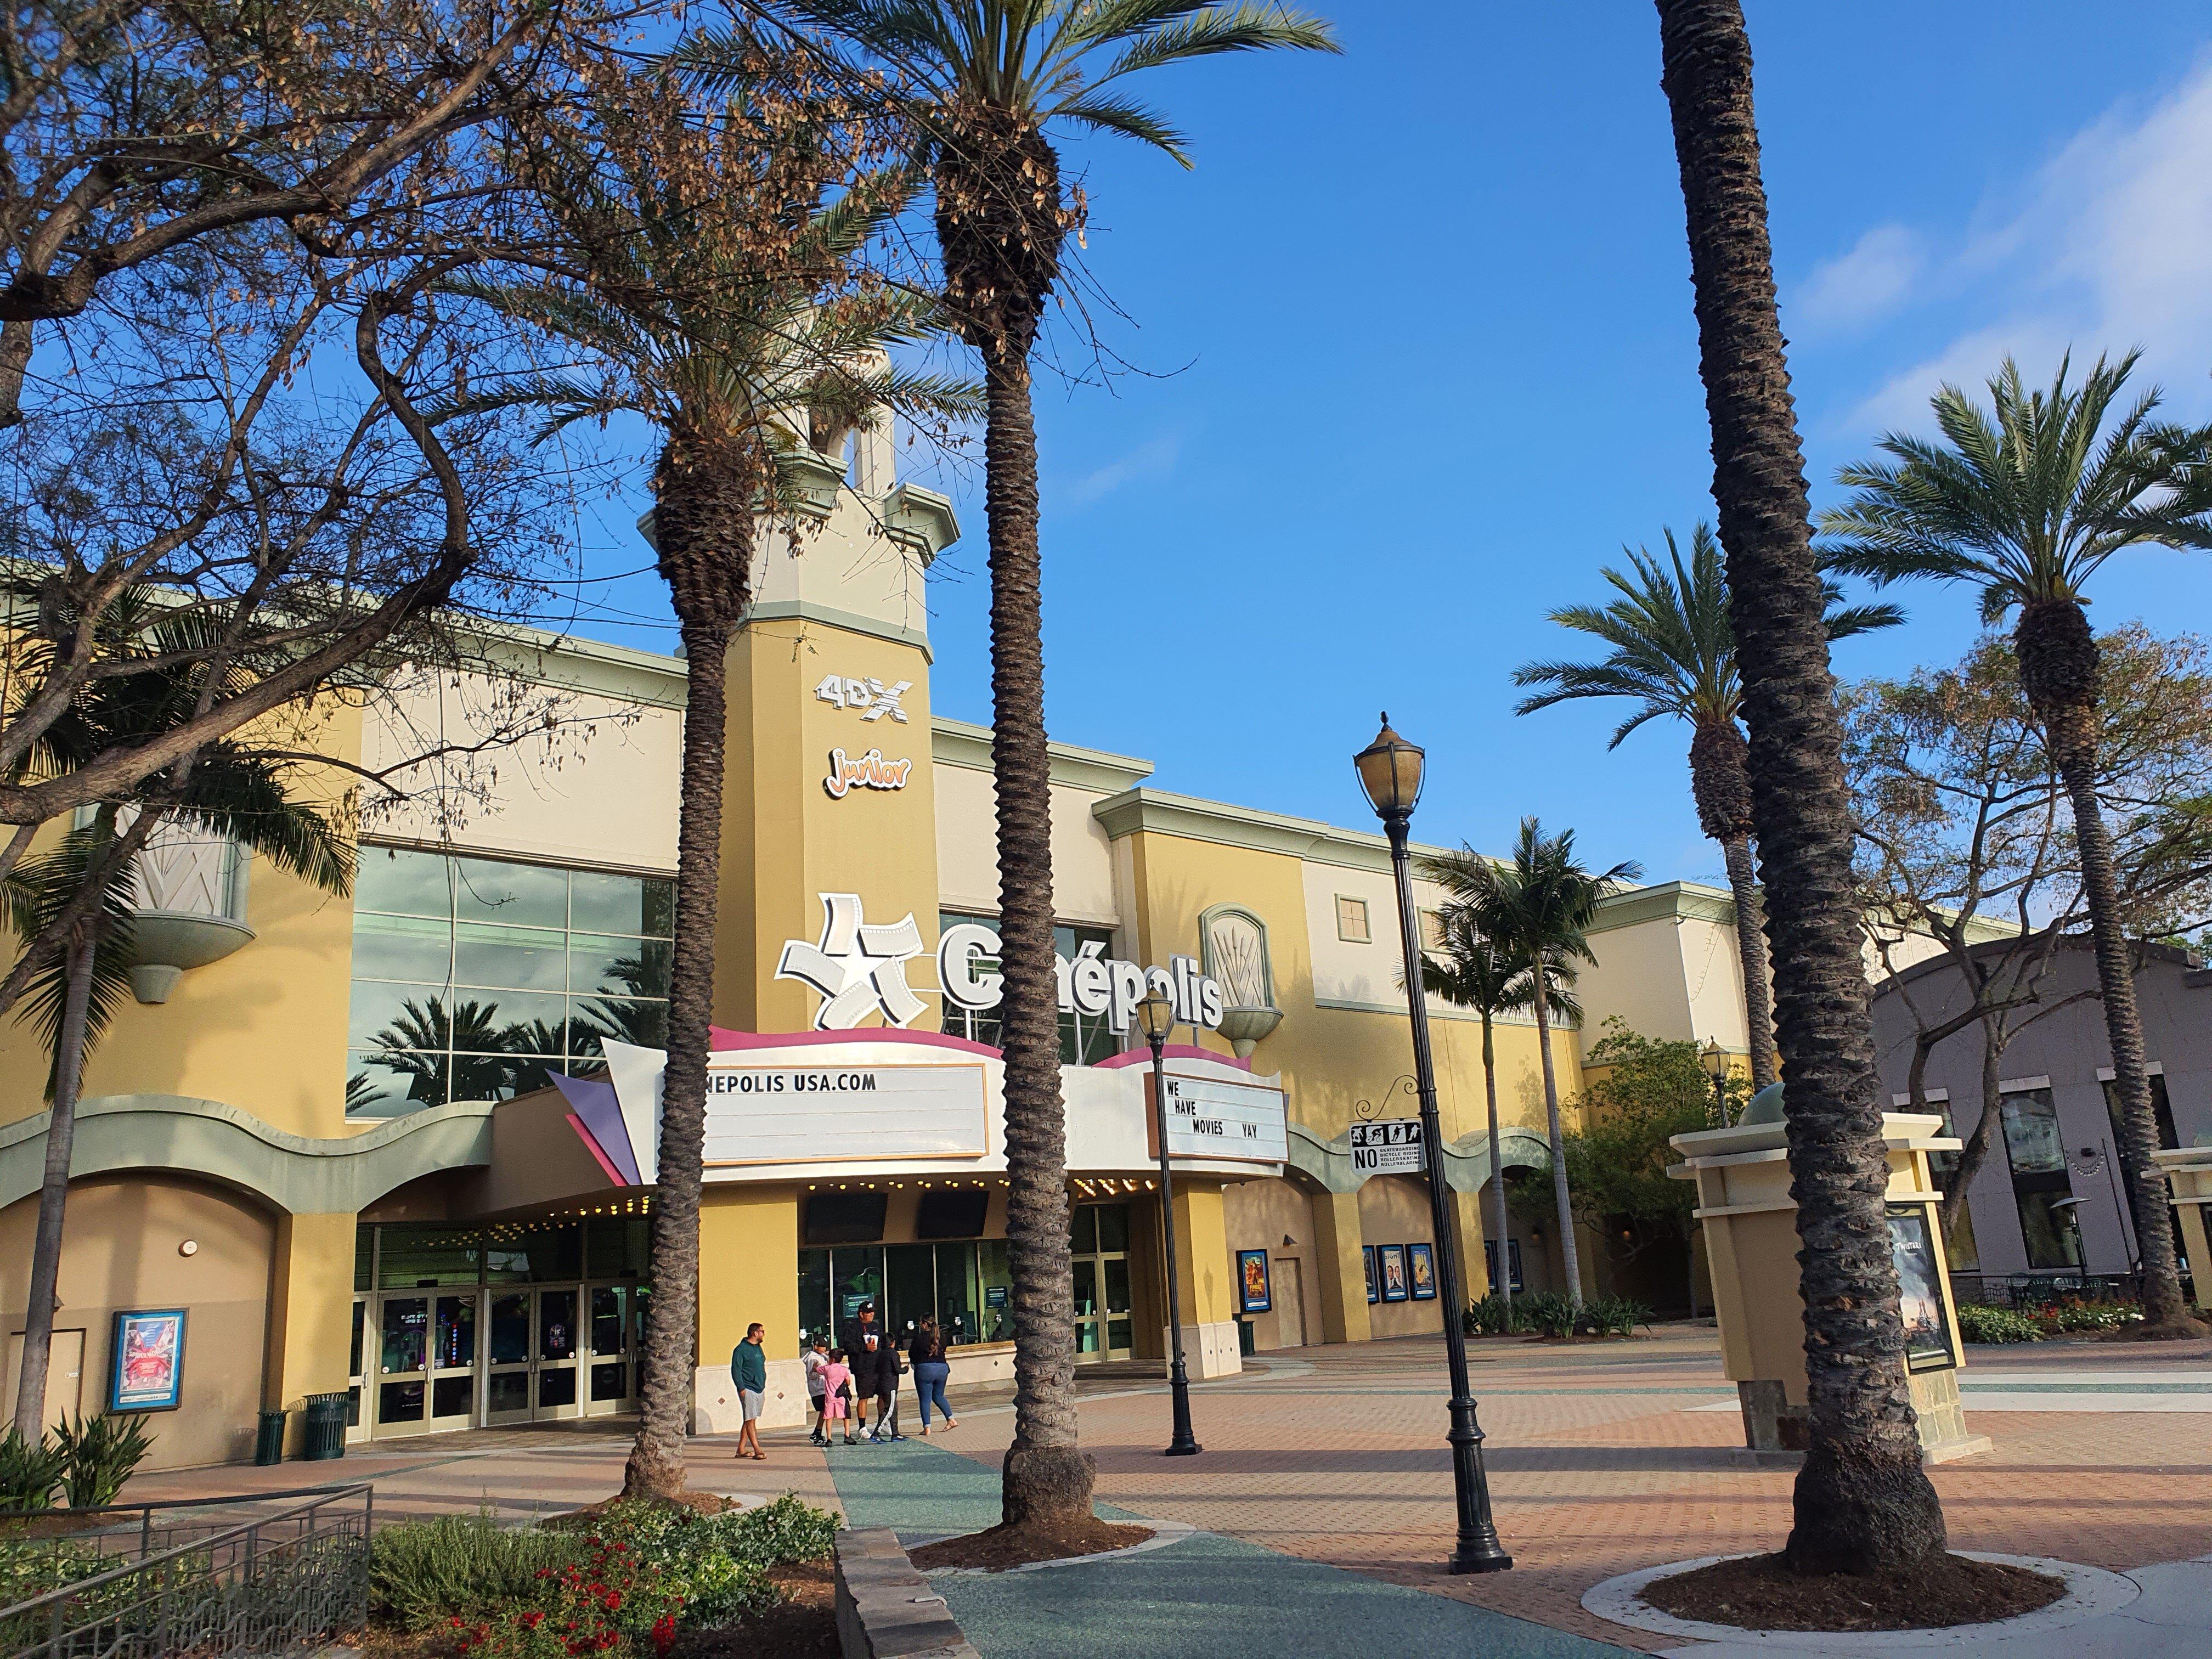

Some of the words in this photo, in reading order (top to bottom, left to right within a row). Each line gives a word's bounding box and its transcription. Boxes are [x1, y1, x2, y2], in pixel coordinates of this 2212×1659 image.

[813, 674, 913, 724] 4DX
[826, 748, 911, 797] junior
[937, 924, 1223, 1036] Cnépolis
[706, 1074, 785, 1093] NEPOLIS
[794, 1073, 877, 1092] USA.COM
[1166, 1080, 1179, 1096] WE
[1175, 1099, 1197, 1116] HAVE
[1193, 1118, 1223, 1136] MOVIES
[1242, 1123, 1257, 1138] YAY
[1354, 1149, 1378, 1169] NO
